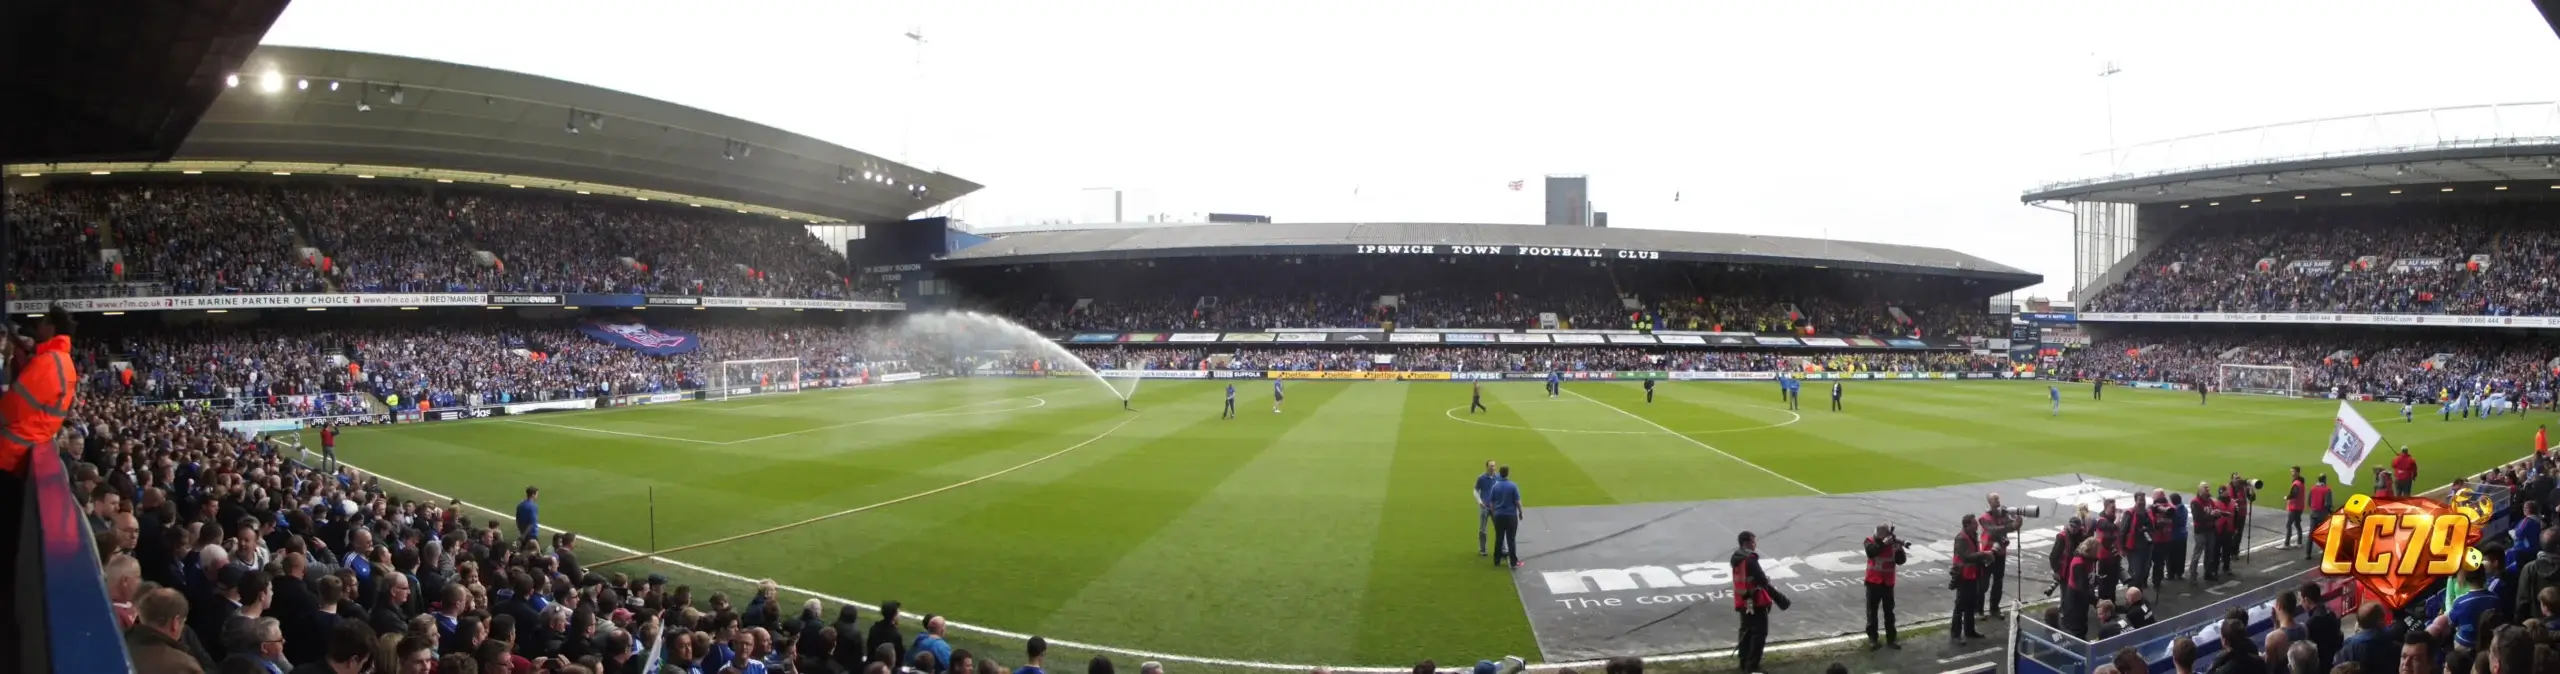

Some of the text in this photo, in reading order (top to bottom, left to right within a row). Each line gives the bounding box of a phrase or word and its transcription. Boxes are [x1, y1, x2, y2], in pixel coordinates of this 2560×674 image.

[1358, 245, 1659, 260] IPSWICH TOWN FOOTBALL CLUB
[198, 298, 237, 306] MARINE
[311, 296, 348, 304] CHOICE
[1556, 597, 1622, 610] The
